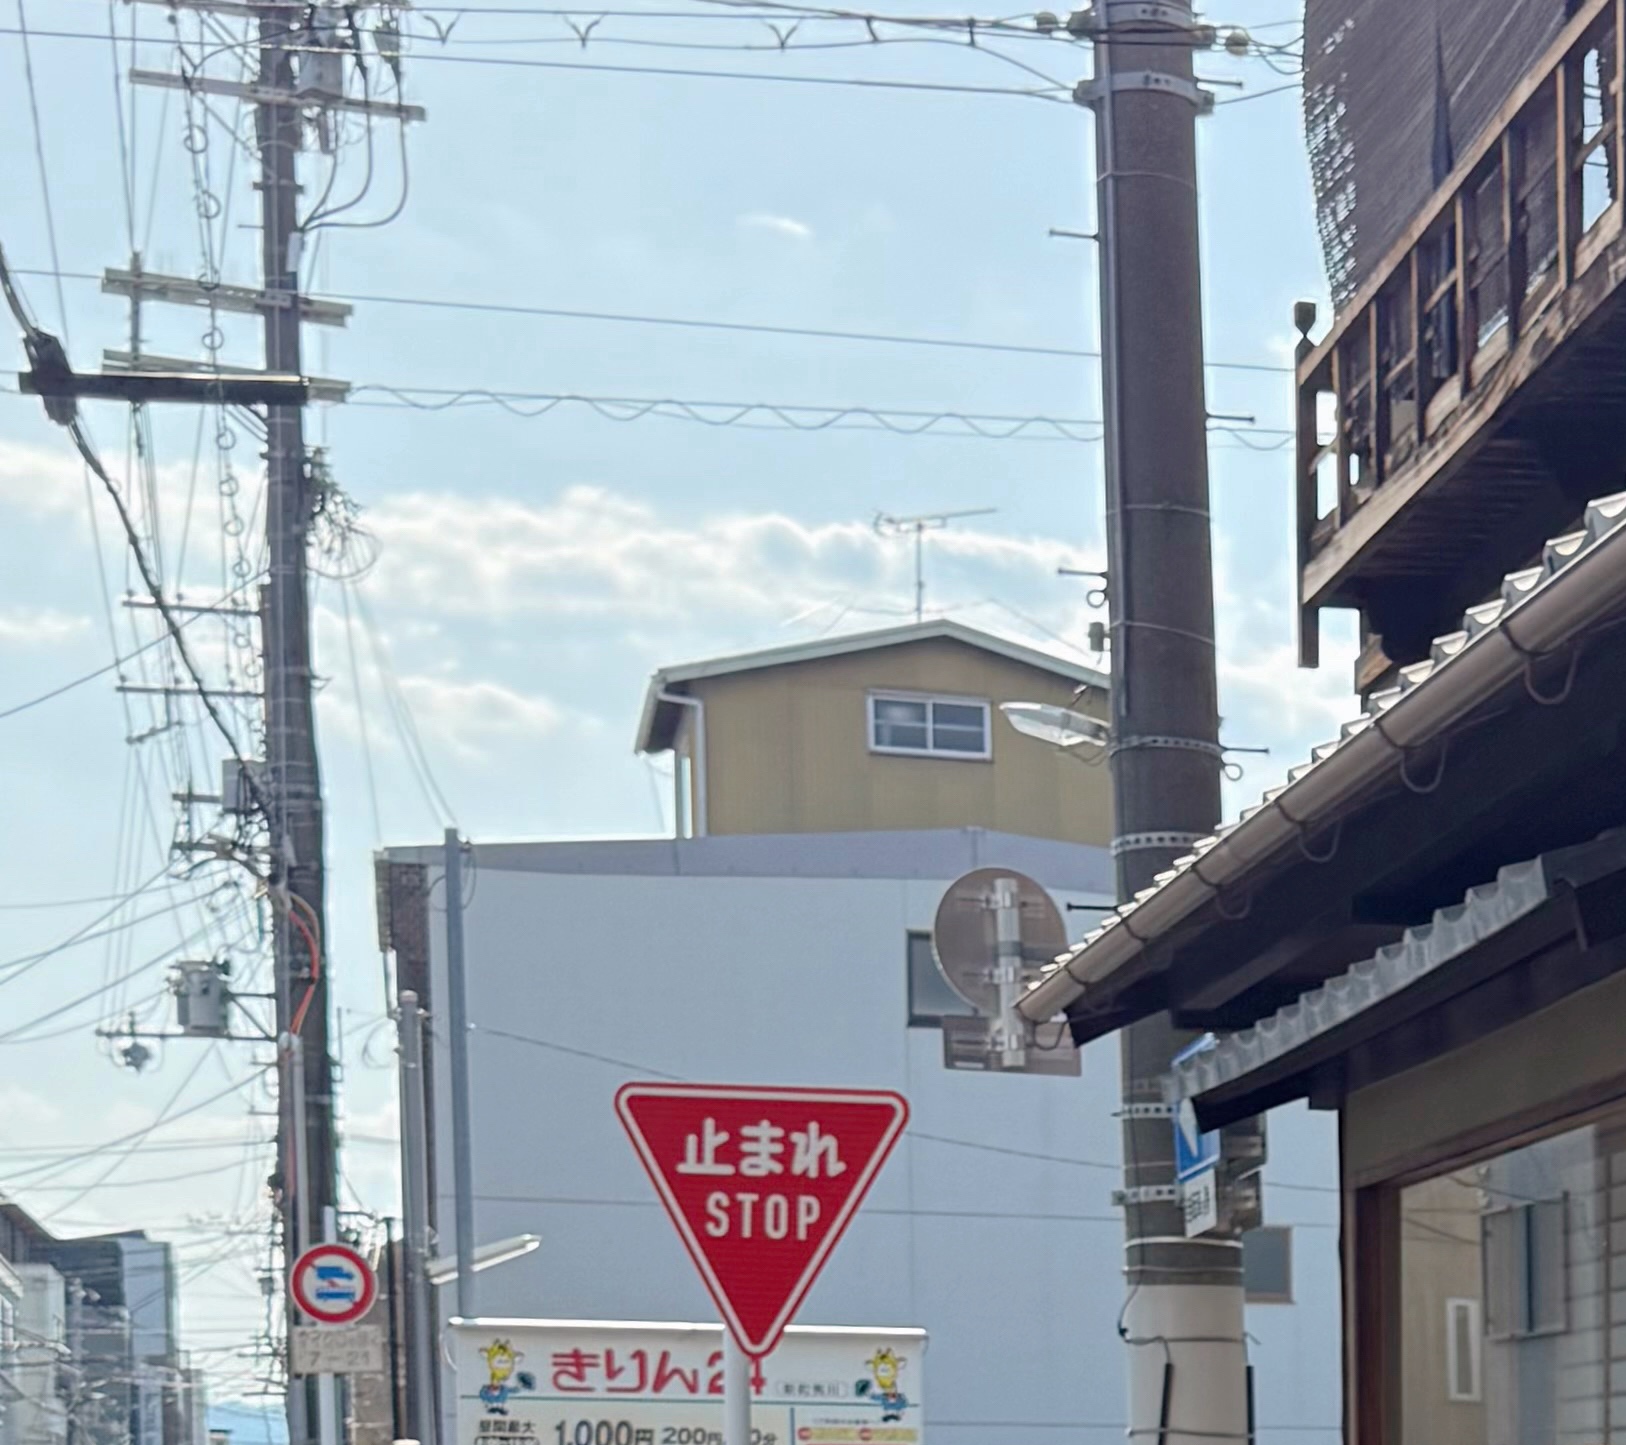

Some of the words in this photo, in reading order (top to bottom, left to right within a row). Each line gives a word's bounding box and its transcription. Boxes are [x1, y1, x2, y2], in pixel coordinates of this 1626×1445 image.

[676, 1117, 847, 1178] 止まれ
[705, 1191, 821, 1241] STOP
